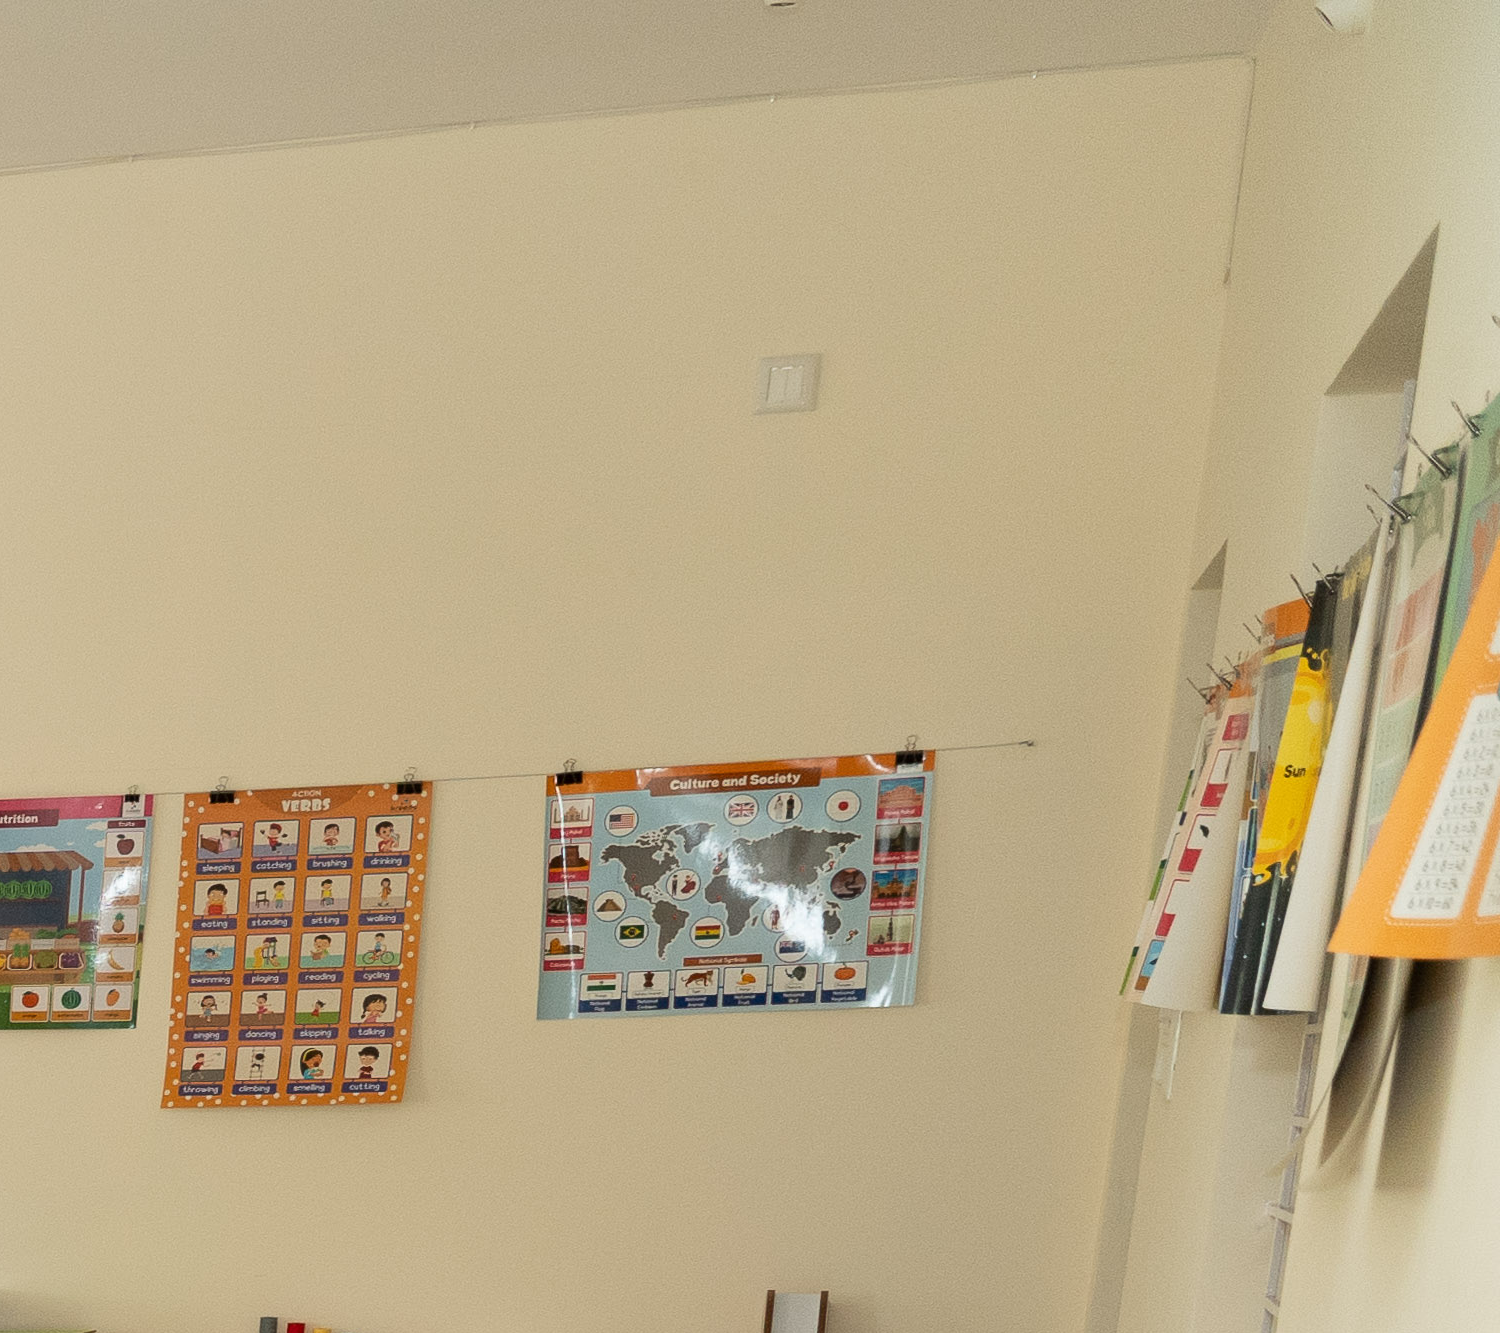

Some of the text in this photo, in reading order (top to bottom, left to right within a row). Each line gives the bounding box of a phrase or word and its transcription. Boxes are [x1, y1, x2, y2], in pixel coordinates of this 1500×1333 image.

[1283, 764, 1307, 778] Sun
[670, 772, 801, 791] Culture and Society
[281, 798, 331, 813] VERBS
[255, 861, 292, 871] catching
[312, 859, 347, 869] brushing
[370, 857, 403, 867] drinking
[251, 918, 288, 928] standing
[310, 915, 340, 926] sitting
[366, 914, 397, 924] walking
[201, 920, 228, 929] eating
[190, 975, 231, 985] swimming
[251, 973, 280, 984] playing
[304, 972, 336, 983] reading
[363, 971, 390, 981] cycling
[245, 1030, 277, 1040] dancing
[299, 1028, 332, 1038] skipping
[357, 1027, 386, 1037] talking
[182, 1085, 219, 1095] throwing
[238, 1083, 271, 1093] climbing
[348, 1082, 381, 1092] cutting
